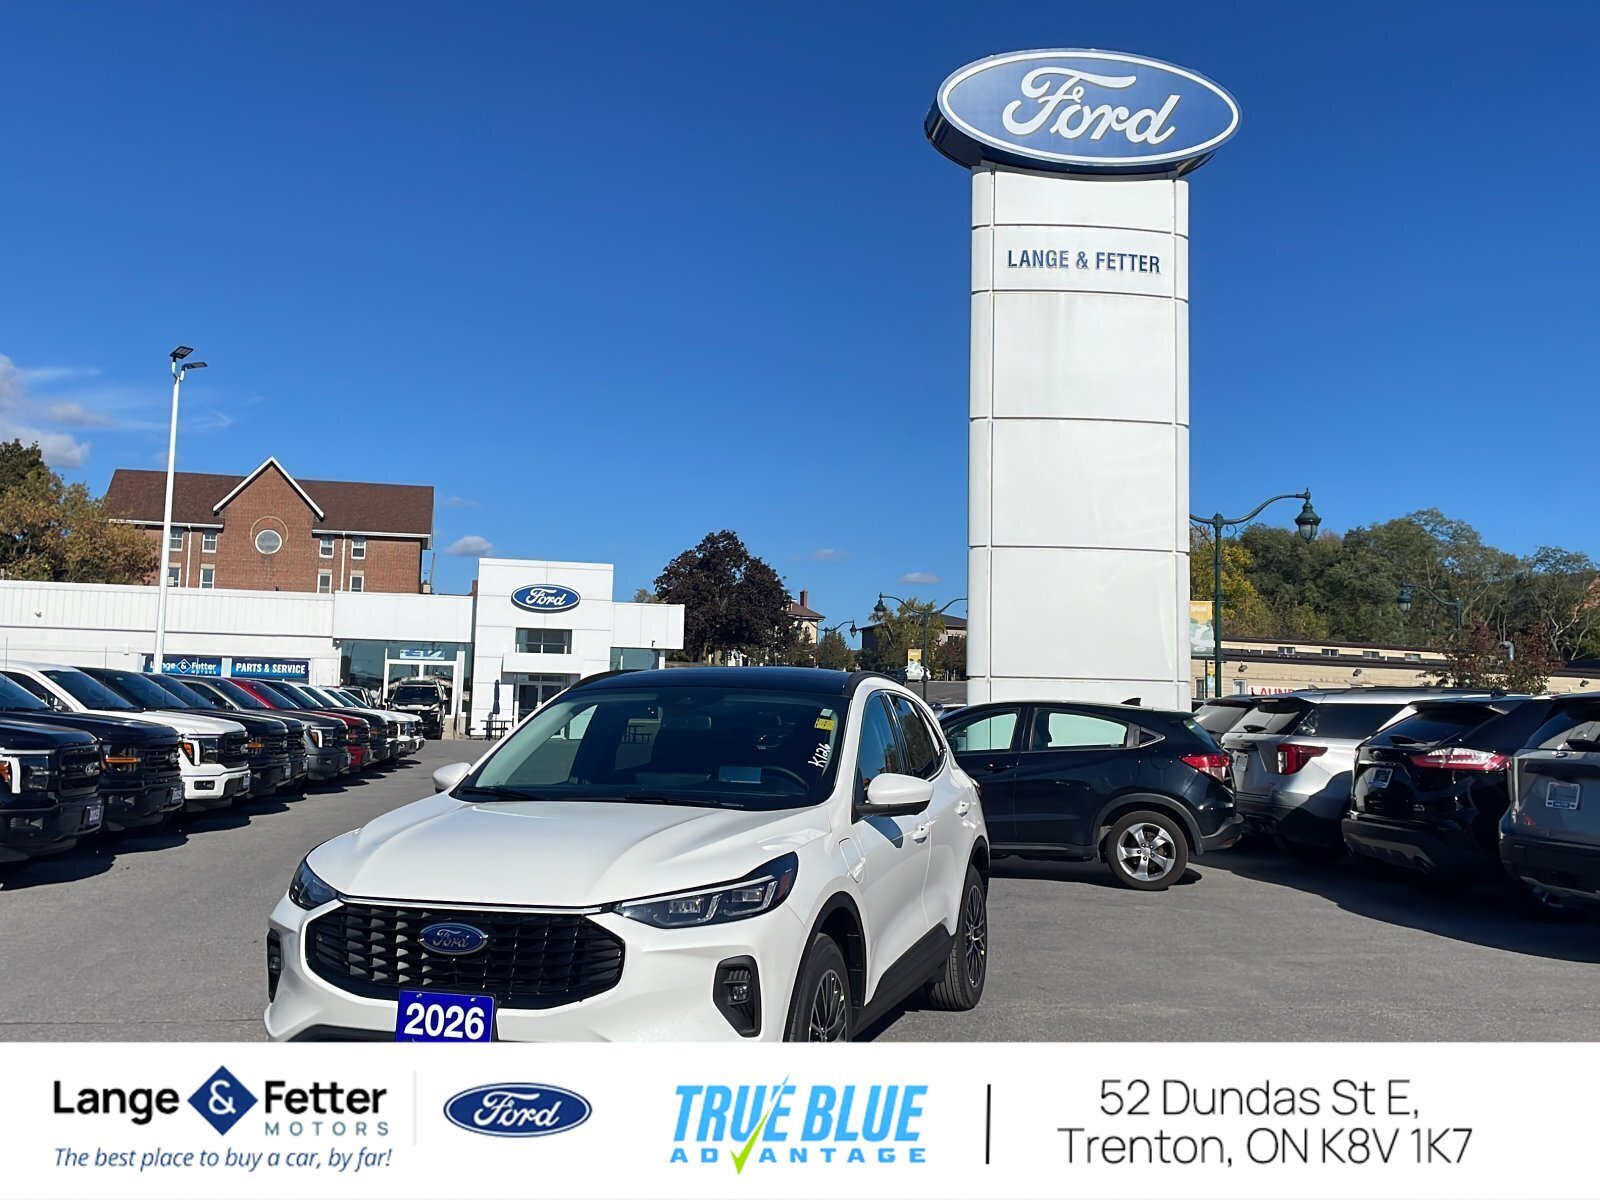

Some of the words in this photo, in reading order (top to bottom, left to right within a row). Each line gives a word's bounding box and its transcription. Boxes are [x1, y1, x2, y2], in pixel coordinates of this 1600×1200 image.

[1002, 66, 1180, 145] Ford
[1007, 249, 1069, 270] LANGE
[1076, 251, 1089, 270] &
[1096, 251, 1161, 275] FETTER
[525, 588, 567, 606] Ford
[236, 662, 262, 673] PARTS
[264, 663, 269, 673] &
[272, 664, 305, 675] SERVICE
[808, 742, 832, 768] K126
[432, 928, 470, 948] Ford
[403, 1002, 485, 1041] 2026
